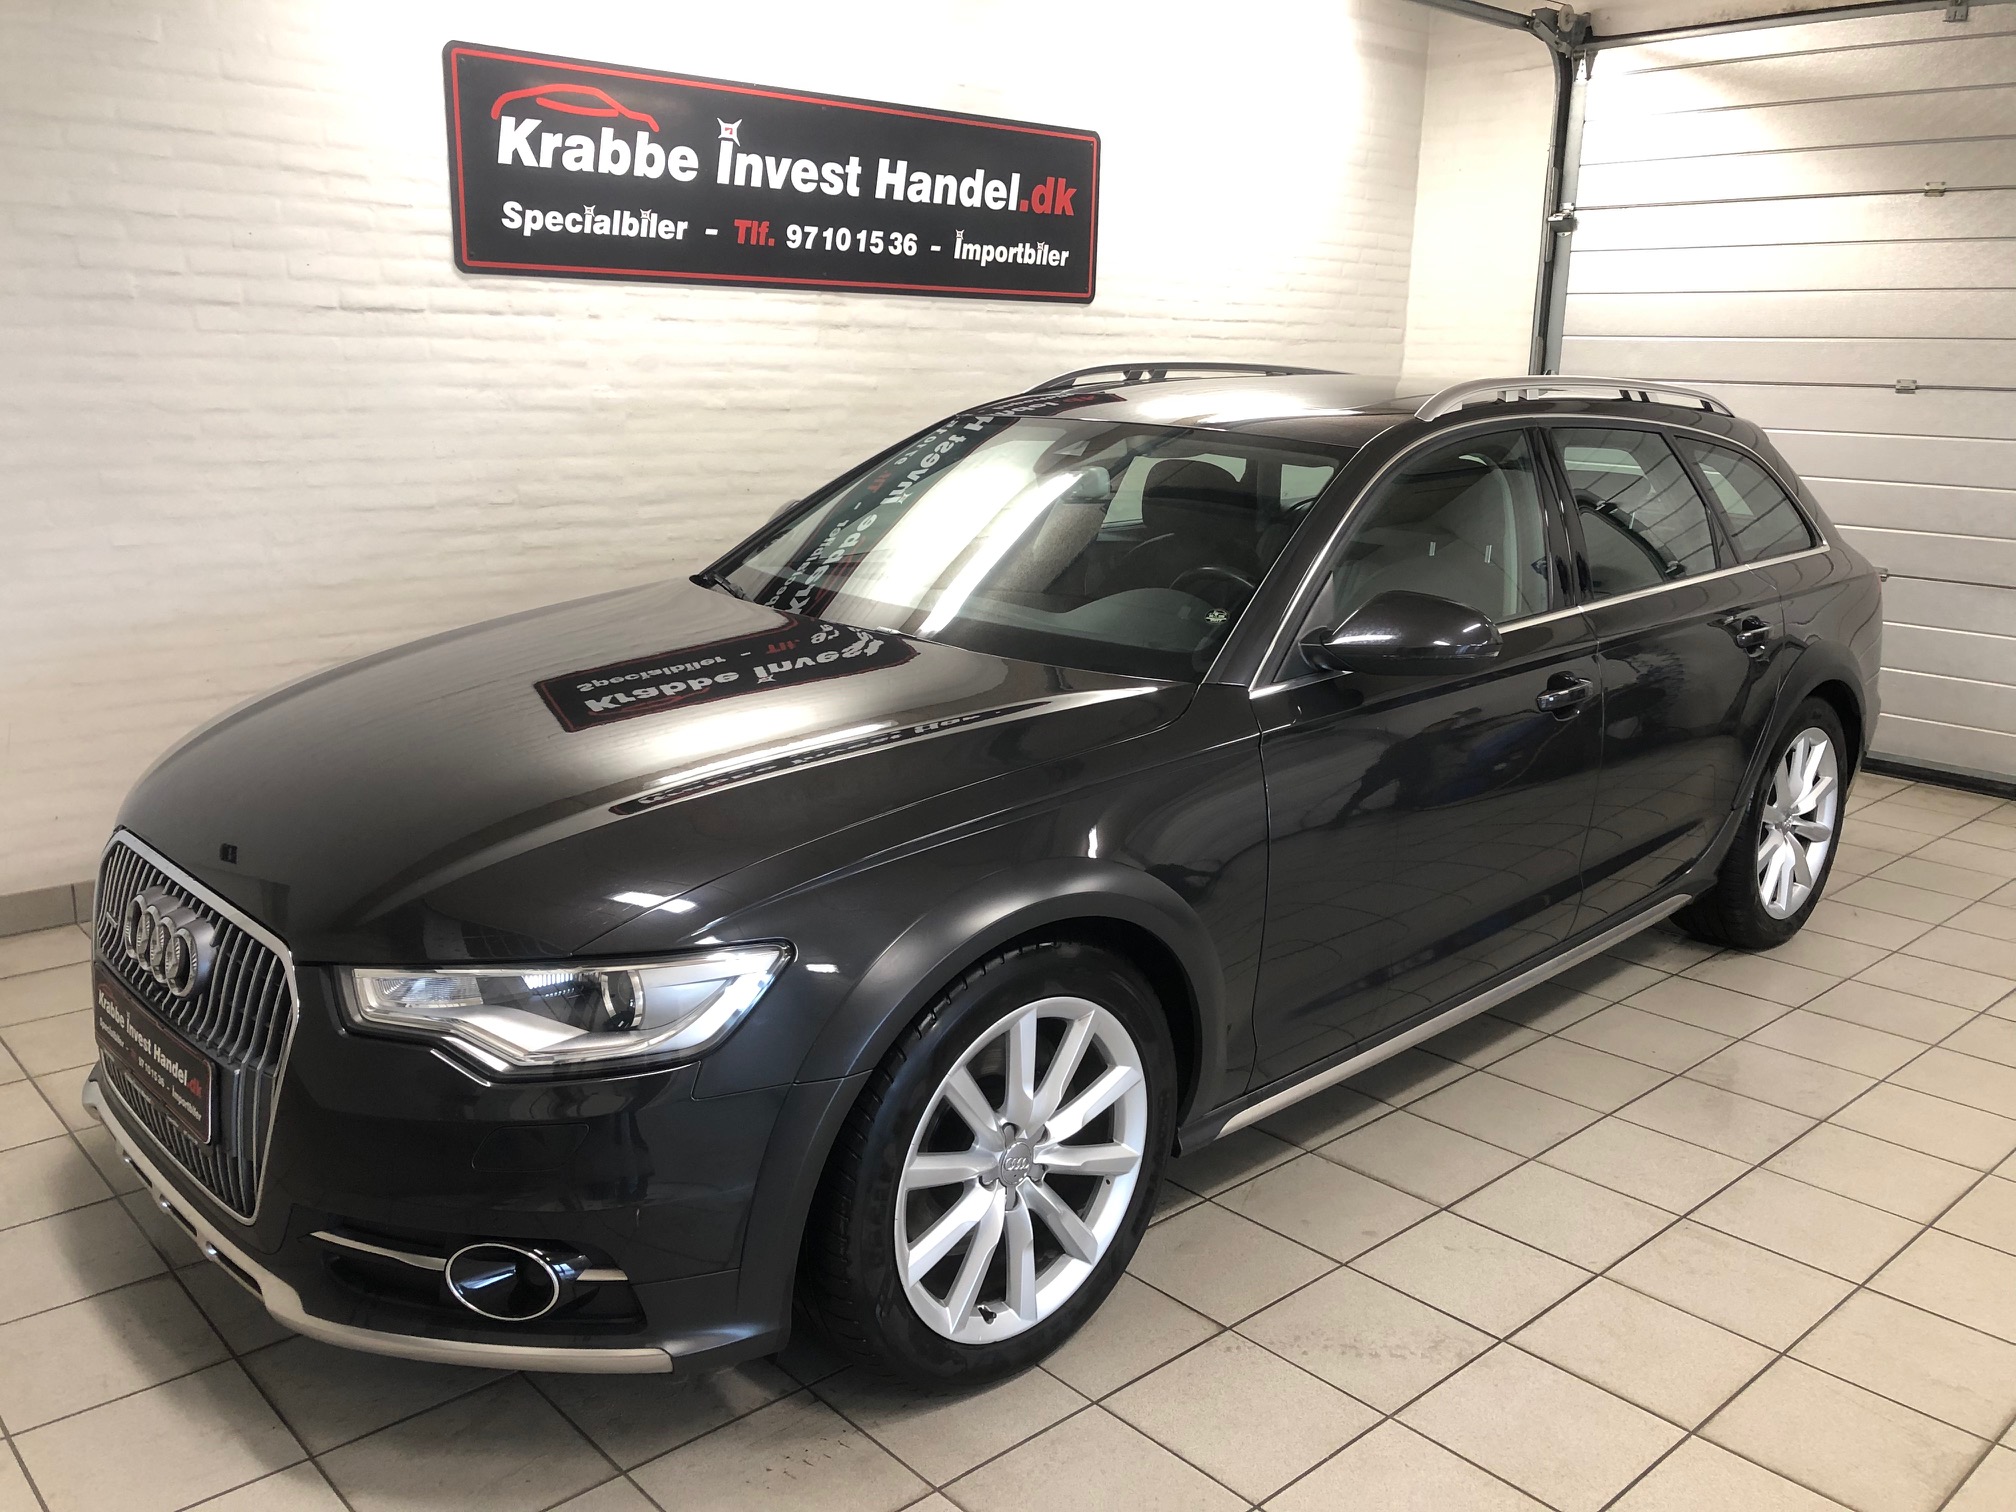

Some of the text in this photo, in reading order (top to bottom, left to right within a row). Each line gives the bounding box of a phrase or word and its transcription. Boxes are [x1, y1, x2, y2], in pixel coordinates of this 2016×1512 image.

[498, 115, 1078, 216] Krabbe Invest Handel.dk
[501, 201, 689, 240] Specialbiler
[734, 219, 775, 247] Tlf.
[953, 229, 1070, 267] Importbiler
[98, 988, 125, 1029] Krabbe
